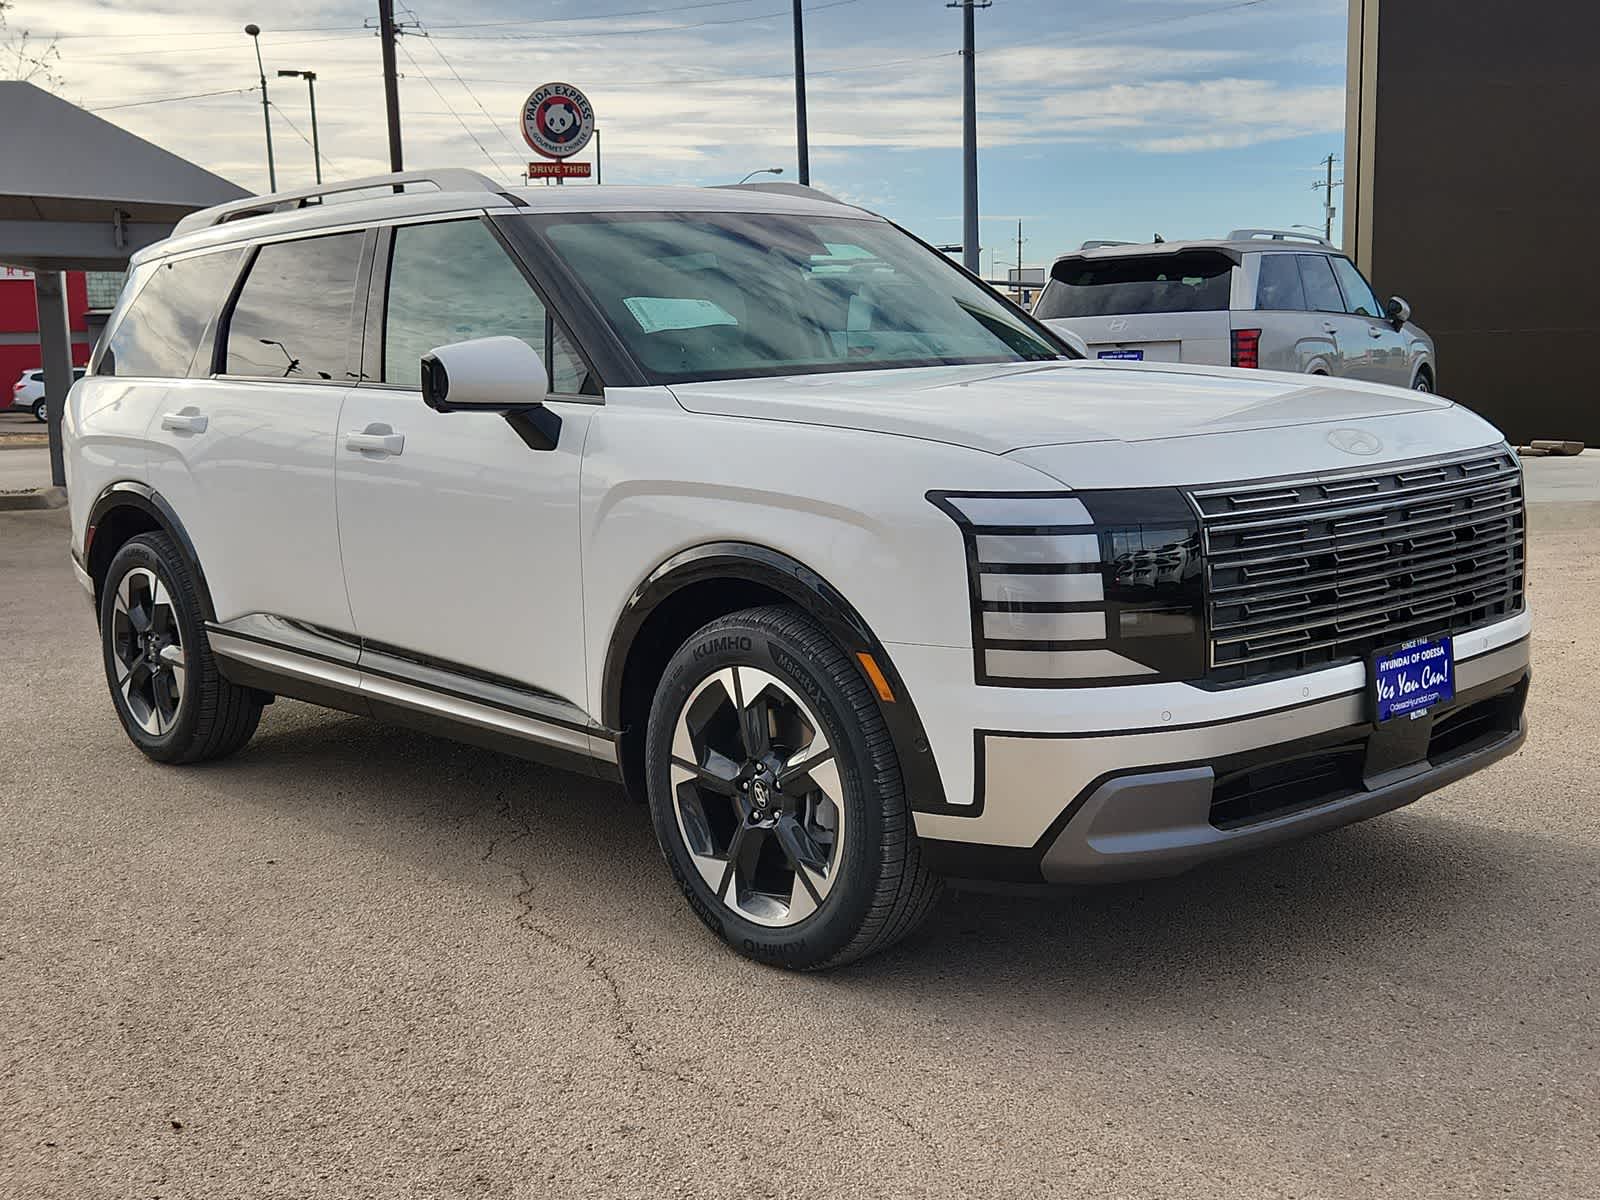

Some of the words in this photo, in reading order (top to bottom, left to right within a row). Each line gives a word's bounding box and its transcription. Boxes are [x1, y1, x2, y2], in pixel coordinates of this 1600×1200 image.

[526, 88, 552, 121] PANDA
[554, 86, 592, 120] EXPRESS
[530, 165, 560, 174] DRIVE
[563, 165, 590, 174] THRU
[692, 636, 752, 661] KUMHO
[1380, 656, 1410, 672] HYUNDAI
[1411, 652, 1420, 664] OF
[1421, 646, 1445, 661] ODESSA
[1376, 677, 1395, 702] Yes
[1398, 671, 1419, 696] You
[1422, 659, 1448, 689] Can!
